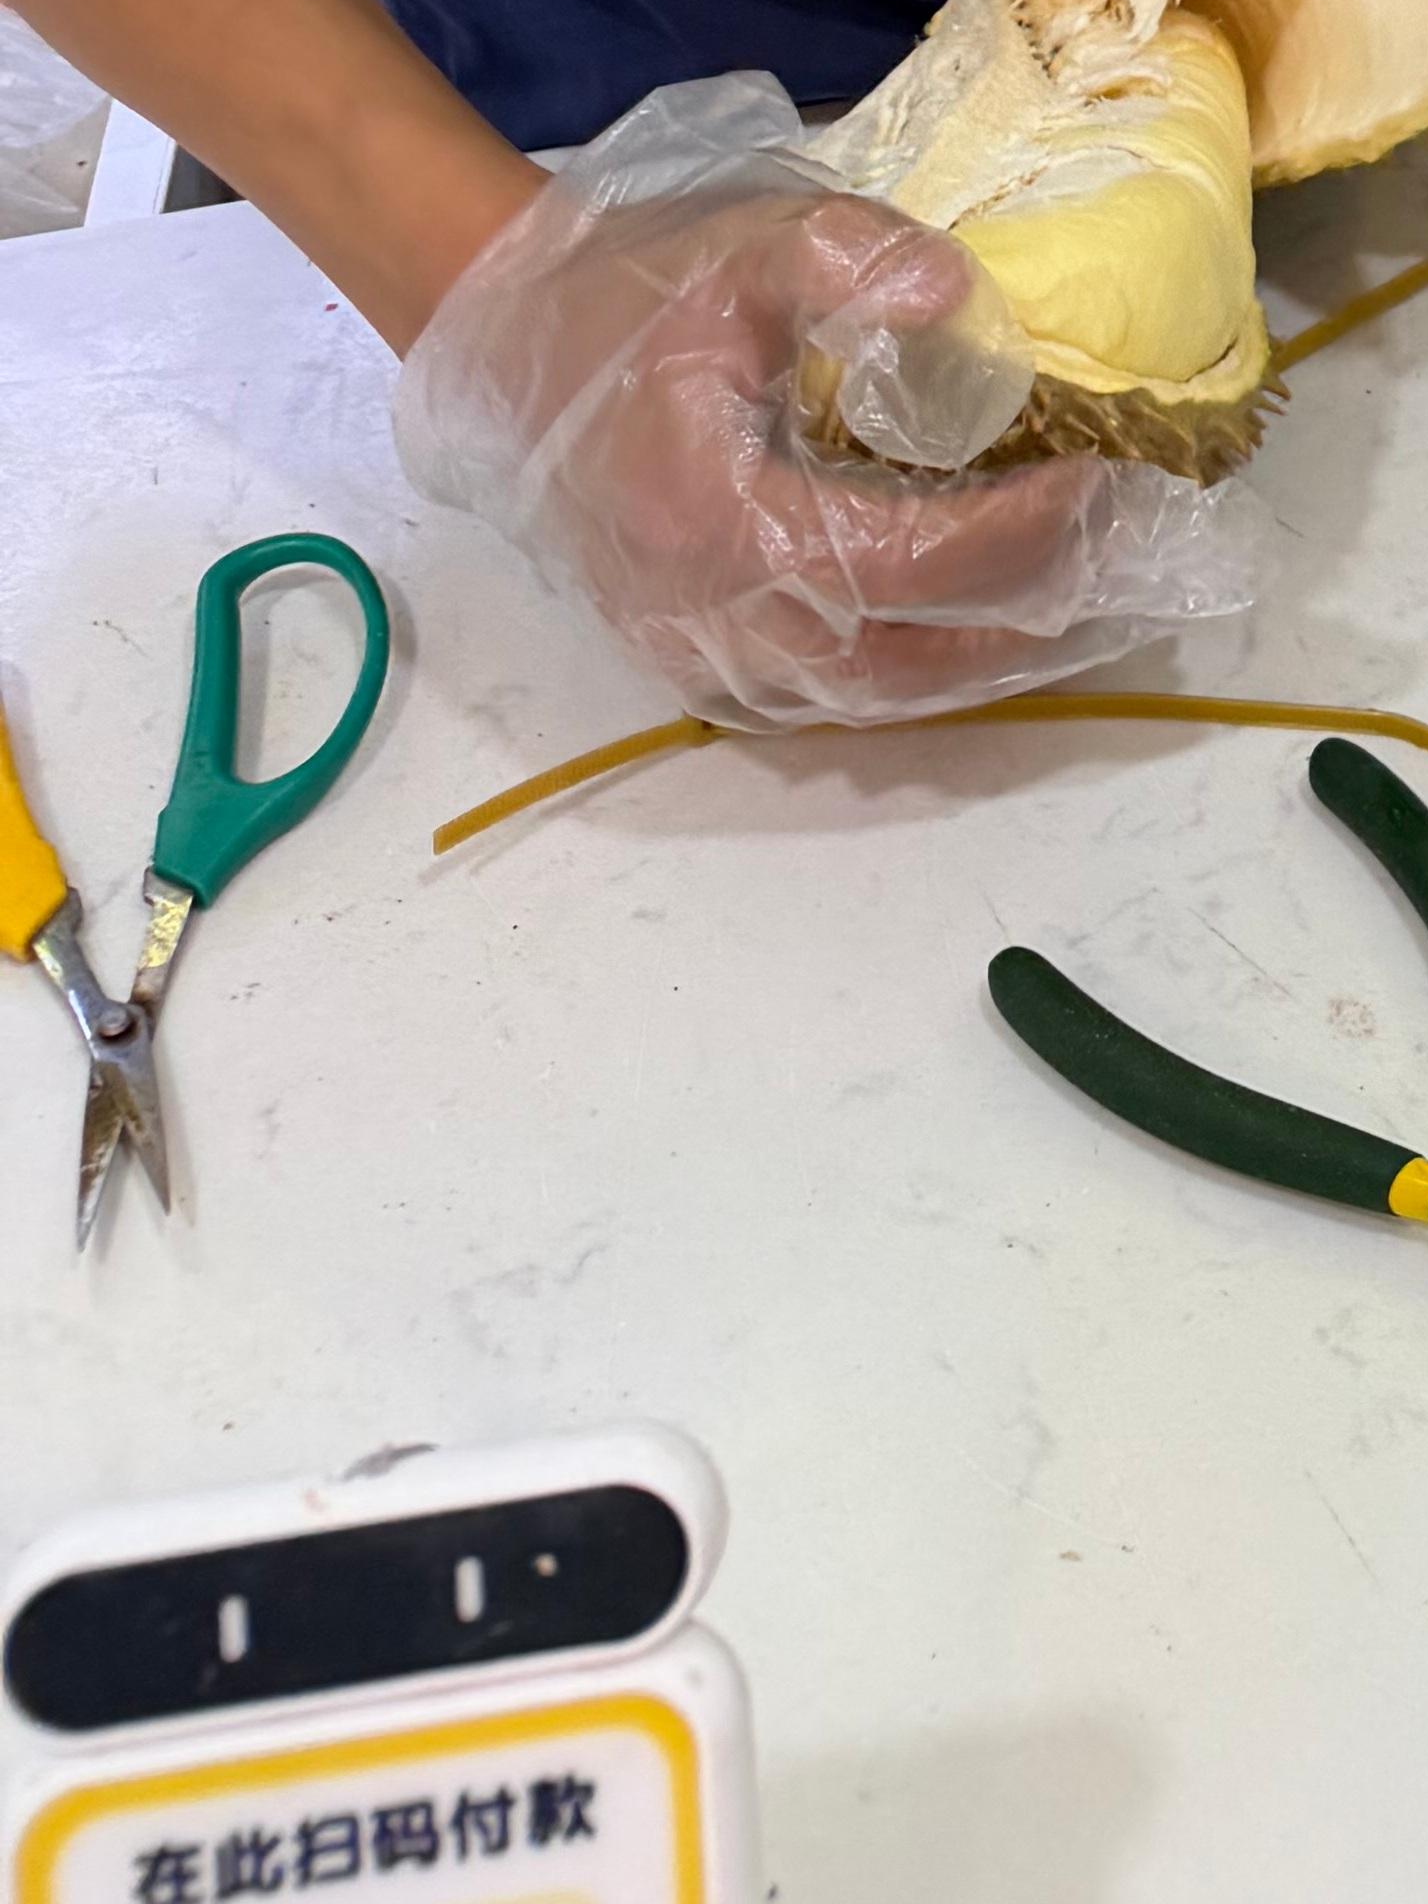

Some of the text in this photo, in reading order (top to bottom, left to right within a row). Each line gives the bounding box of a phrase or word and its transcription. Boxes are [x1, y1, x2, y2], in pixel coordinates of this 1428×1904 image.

[134, 1774, 597, 1904] 在此扫码付款
